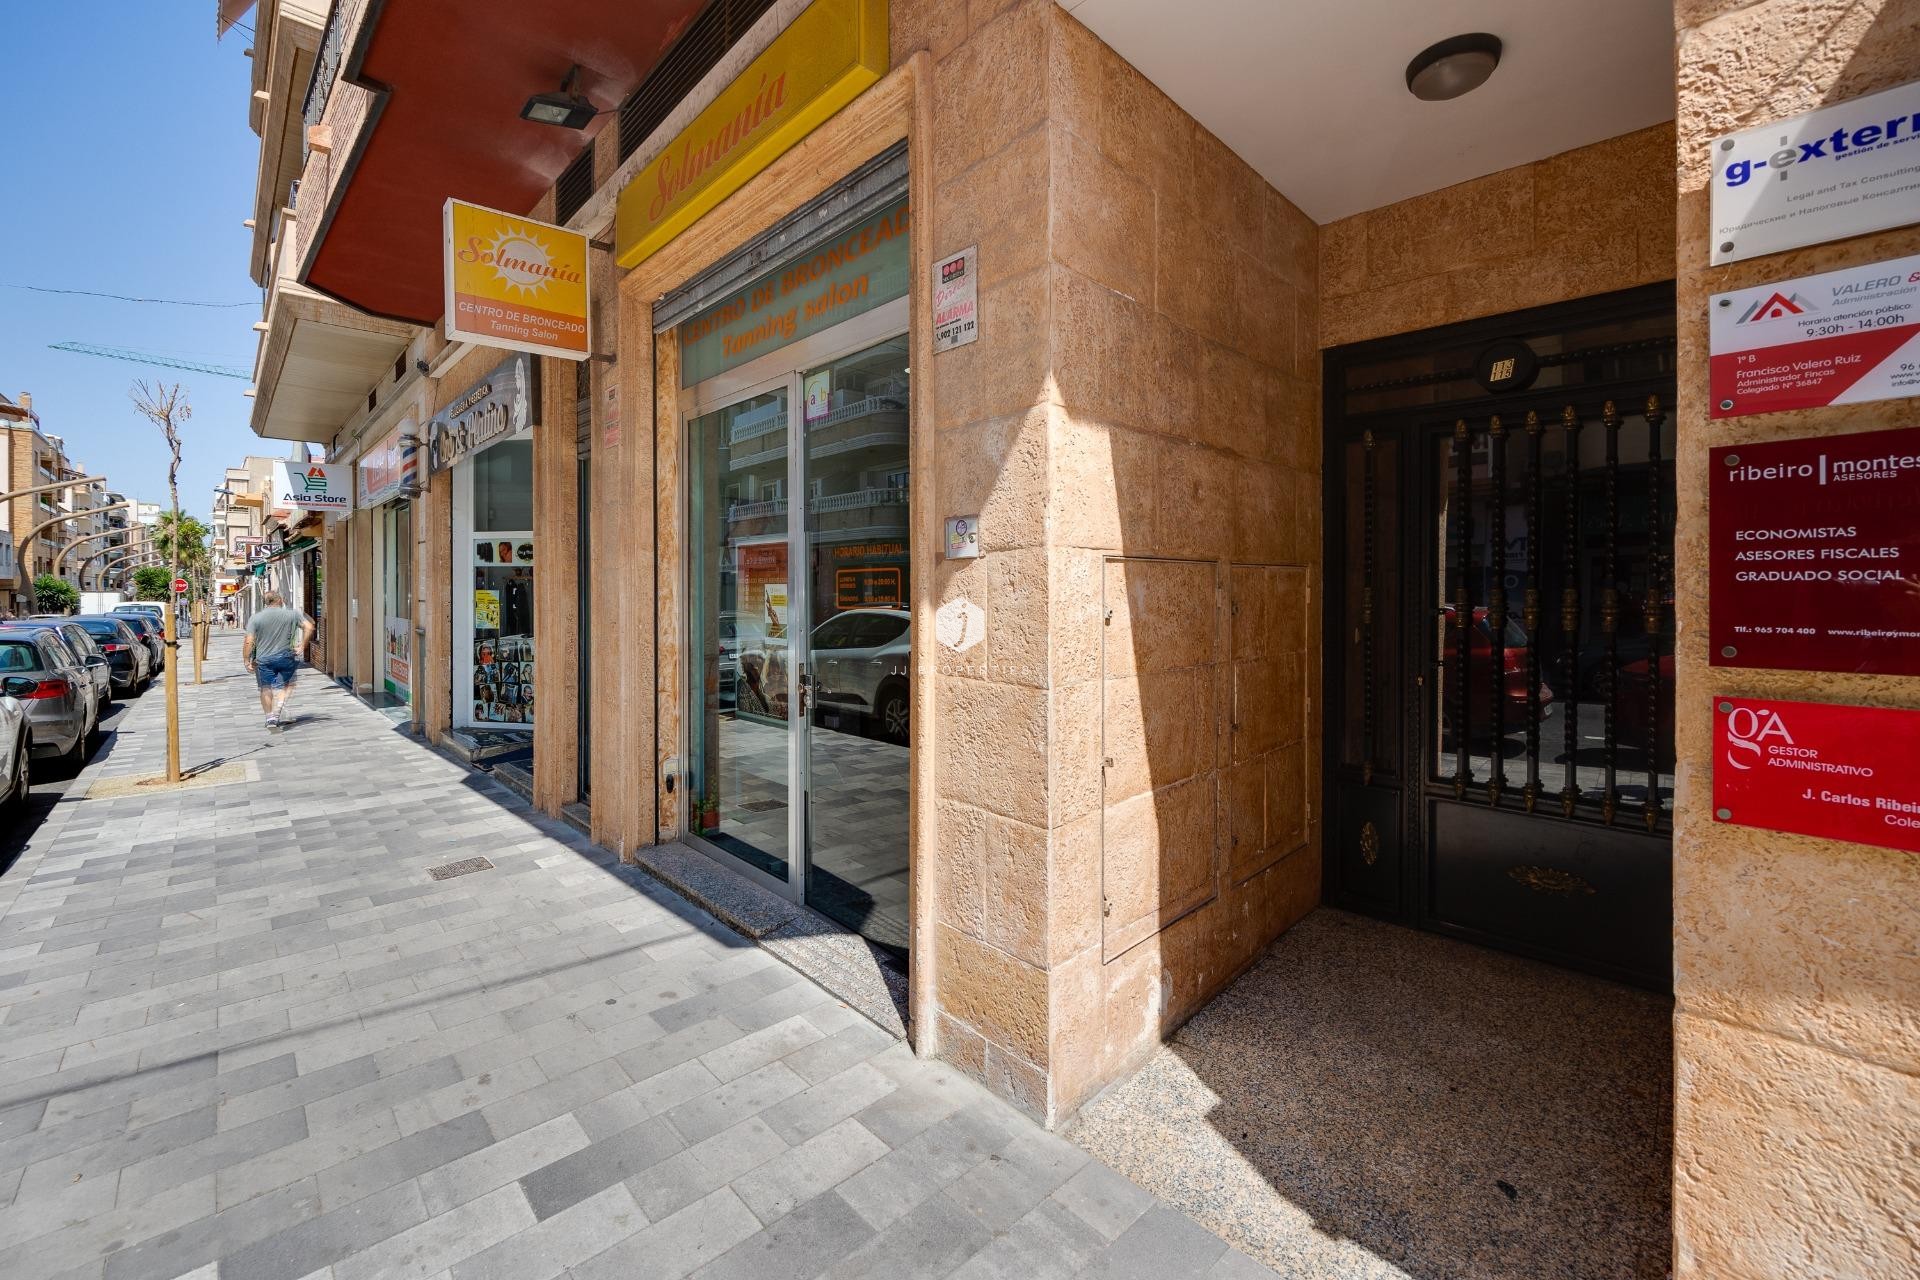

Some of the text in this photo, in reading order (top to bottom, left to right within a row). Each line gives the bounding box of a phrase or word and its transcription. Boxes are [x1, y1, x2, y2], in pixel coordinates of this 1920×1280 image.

[1787, 191, 1814, 202] Legal
[1817, 185, 1836, 195] and
[1840, 181, 1857, 189] Tax
[457, 236, 583, 284] Solmanía
[1832, 275, 1902, 296] VALERO
[751, 281, 775, 313] DE
[1832, 286, 1917, 306] Administración
[459, 302, 585, 333] CENTRO DE BRONCEADO
[722, 275, 870, 358] Tanning salon
[936, 301, 974, 325] ALARMA
[1798, 316, 1831, 327] Horario
[1833, 309, 1873, 320] atención
[491, 321, 558, 340] Tanning Salon
[940, 329, 951, 339] 902
[952, 325, 962, 336] 121
[964, 321, 975, 331] 122
[1807, 324, 1844, 338] 9:30h
[1858, 314, 1904, 329] 14:00h
[1736, 354, 1862, 379] Francisco Valero Ruiz
[1748, 355, 1757, 363] B
[1900, 363, 1915, 371] 96
[1736, 368, 1836, 388] Administrador Fincas
[1736, 384, 1780, 395] Colegiado
[1729, 464, 1813, 482] ribeiro
[1833, 470, 1897, 481] ASESORES
[283, 493, 347, 503] Asia Store
[1735, 526, 1857, 541] ECONOMISTAS
[1735, 548, 1900, 561] ASESORES FISCALES
[1735, 569, 1905, 582] GRADUADO SOCIAL
[1754, 626, 1773, 634] 965
[1796, 627, 1816, 635] 400
[1768, 745, 1818, 759] GESTOR
[1767, 757, 1874, 777] ADMINISTRATIVO
[1802, 788, 1816, 800] J.
[1820, 790, 1871, 807] Carlos
